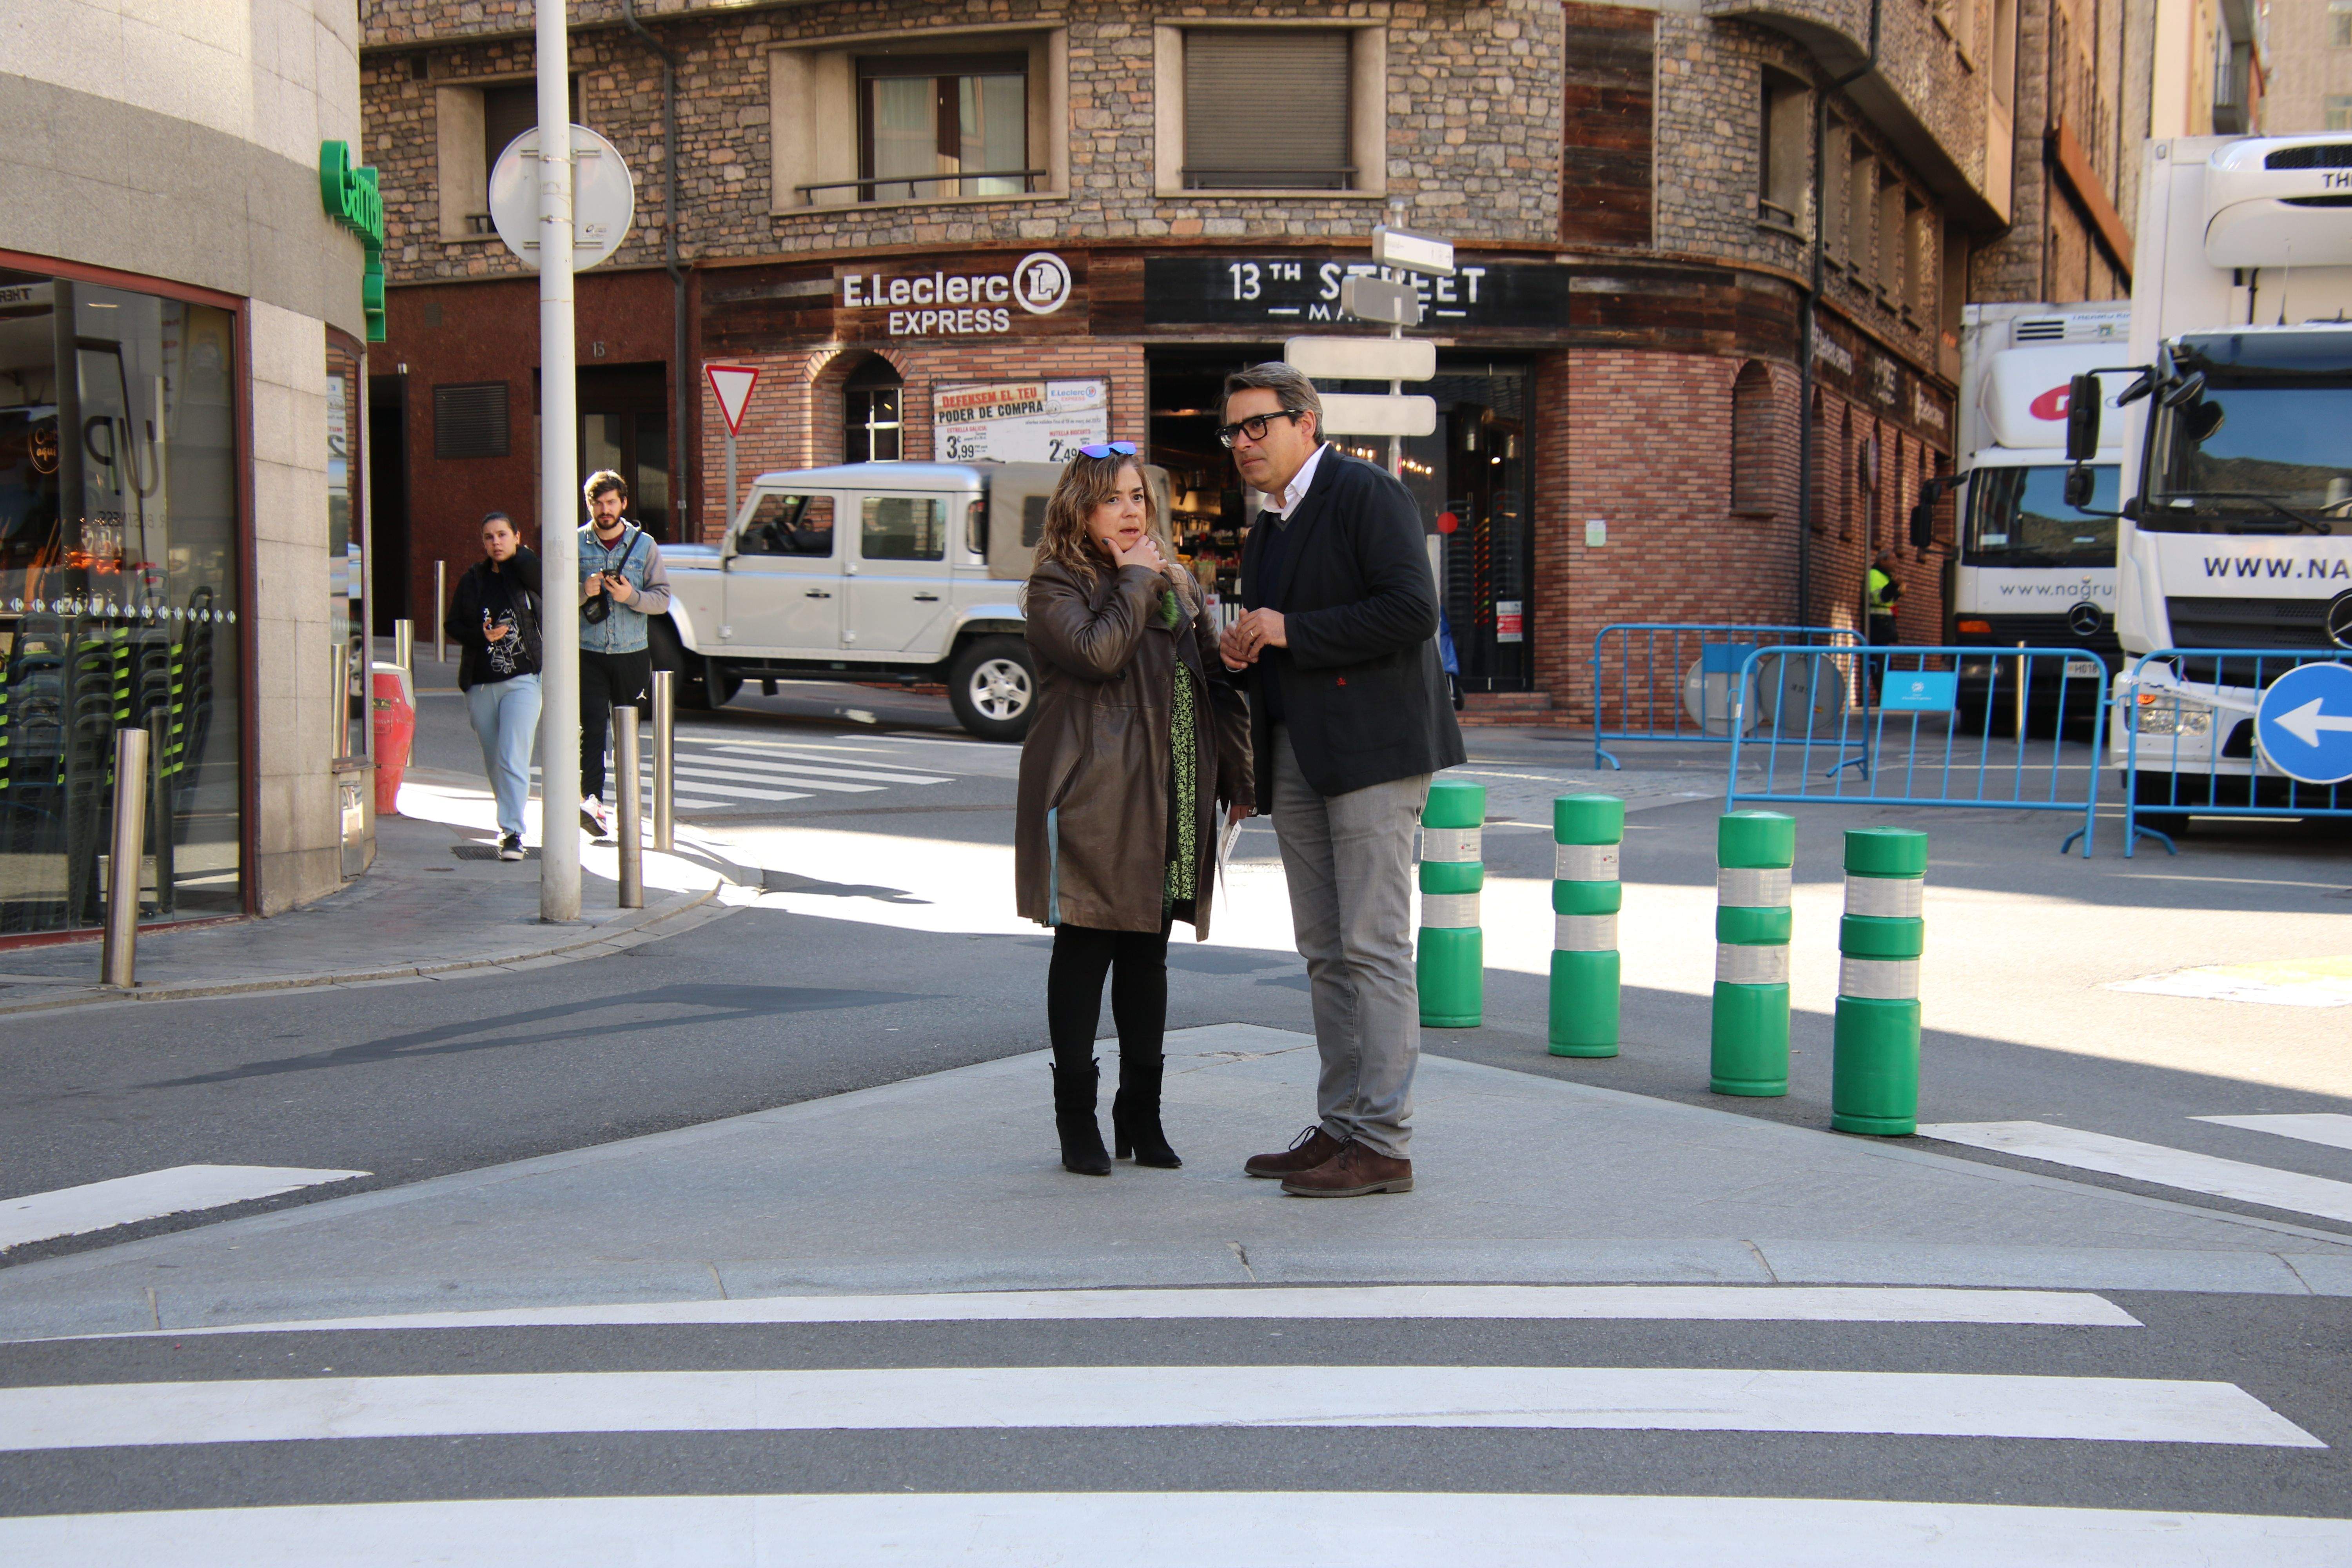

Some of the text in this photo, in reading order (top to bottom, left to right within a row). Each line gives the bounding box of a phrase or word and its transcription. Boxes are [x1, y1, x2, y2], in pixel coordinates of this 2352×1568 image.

[844, 271, 1009, 307] E.Leclerc
[1229, 263, 1261, 300] 13
[1269, 263, 1301, 280] TH
[889, 308, 1010, 335] EXPRESS
[942, 387, 1038, 408] DEFENSEM EL TEU
[938, 400, 1044, 423] PODER DE COMPRA
[2204, 557, 2350, 579] WWW.NA
